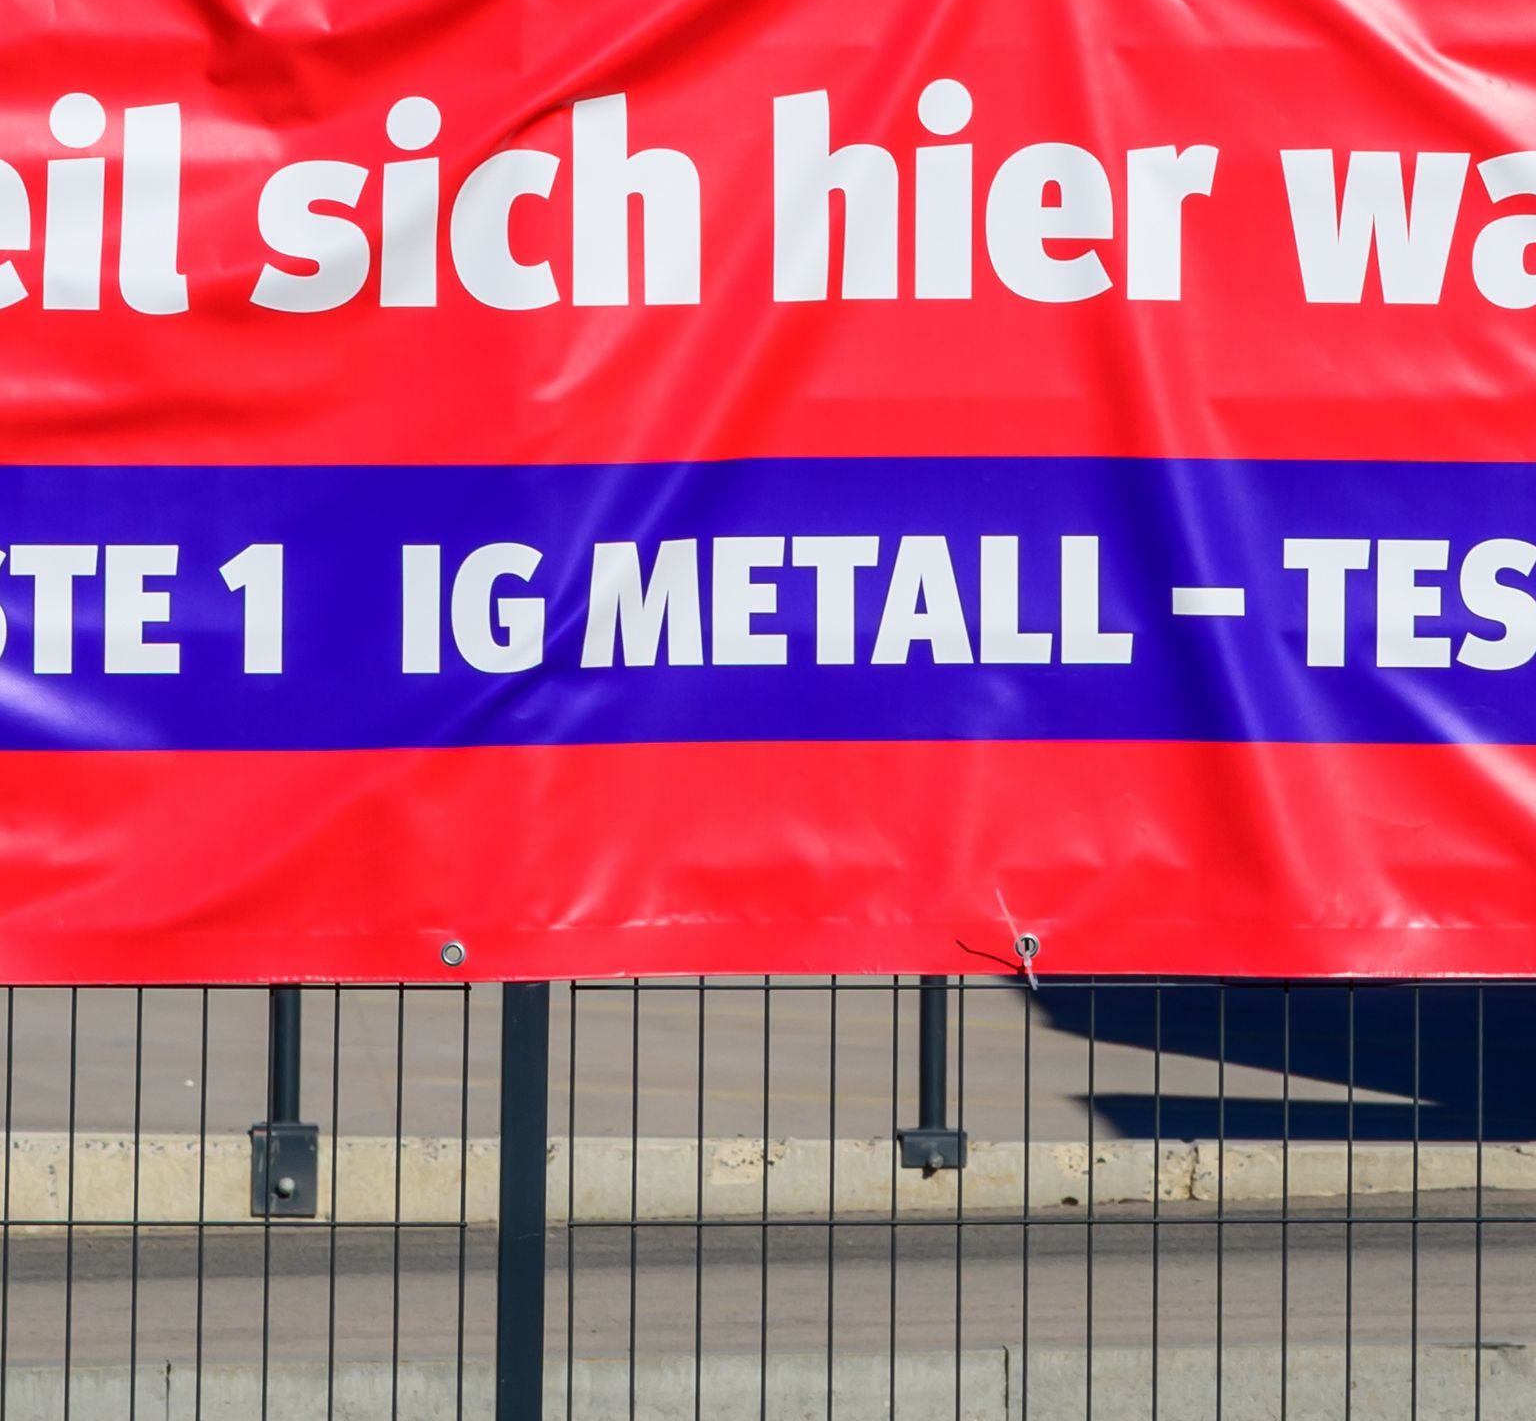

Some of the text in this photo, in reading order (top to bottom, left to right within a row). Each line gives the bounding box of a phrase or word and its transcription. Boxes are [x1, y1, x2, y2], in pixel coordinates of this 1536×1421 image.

[250, 92, 701, 313] sich
[773, 78, 1220, 303] hier
[218, 543, 284, 674] 1
[401, 541, 546, 674] IG
[579, 534, 1134, 669] METALL
